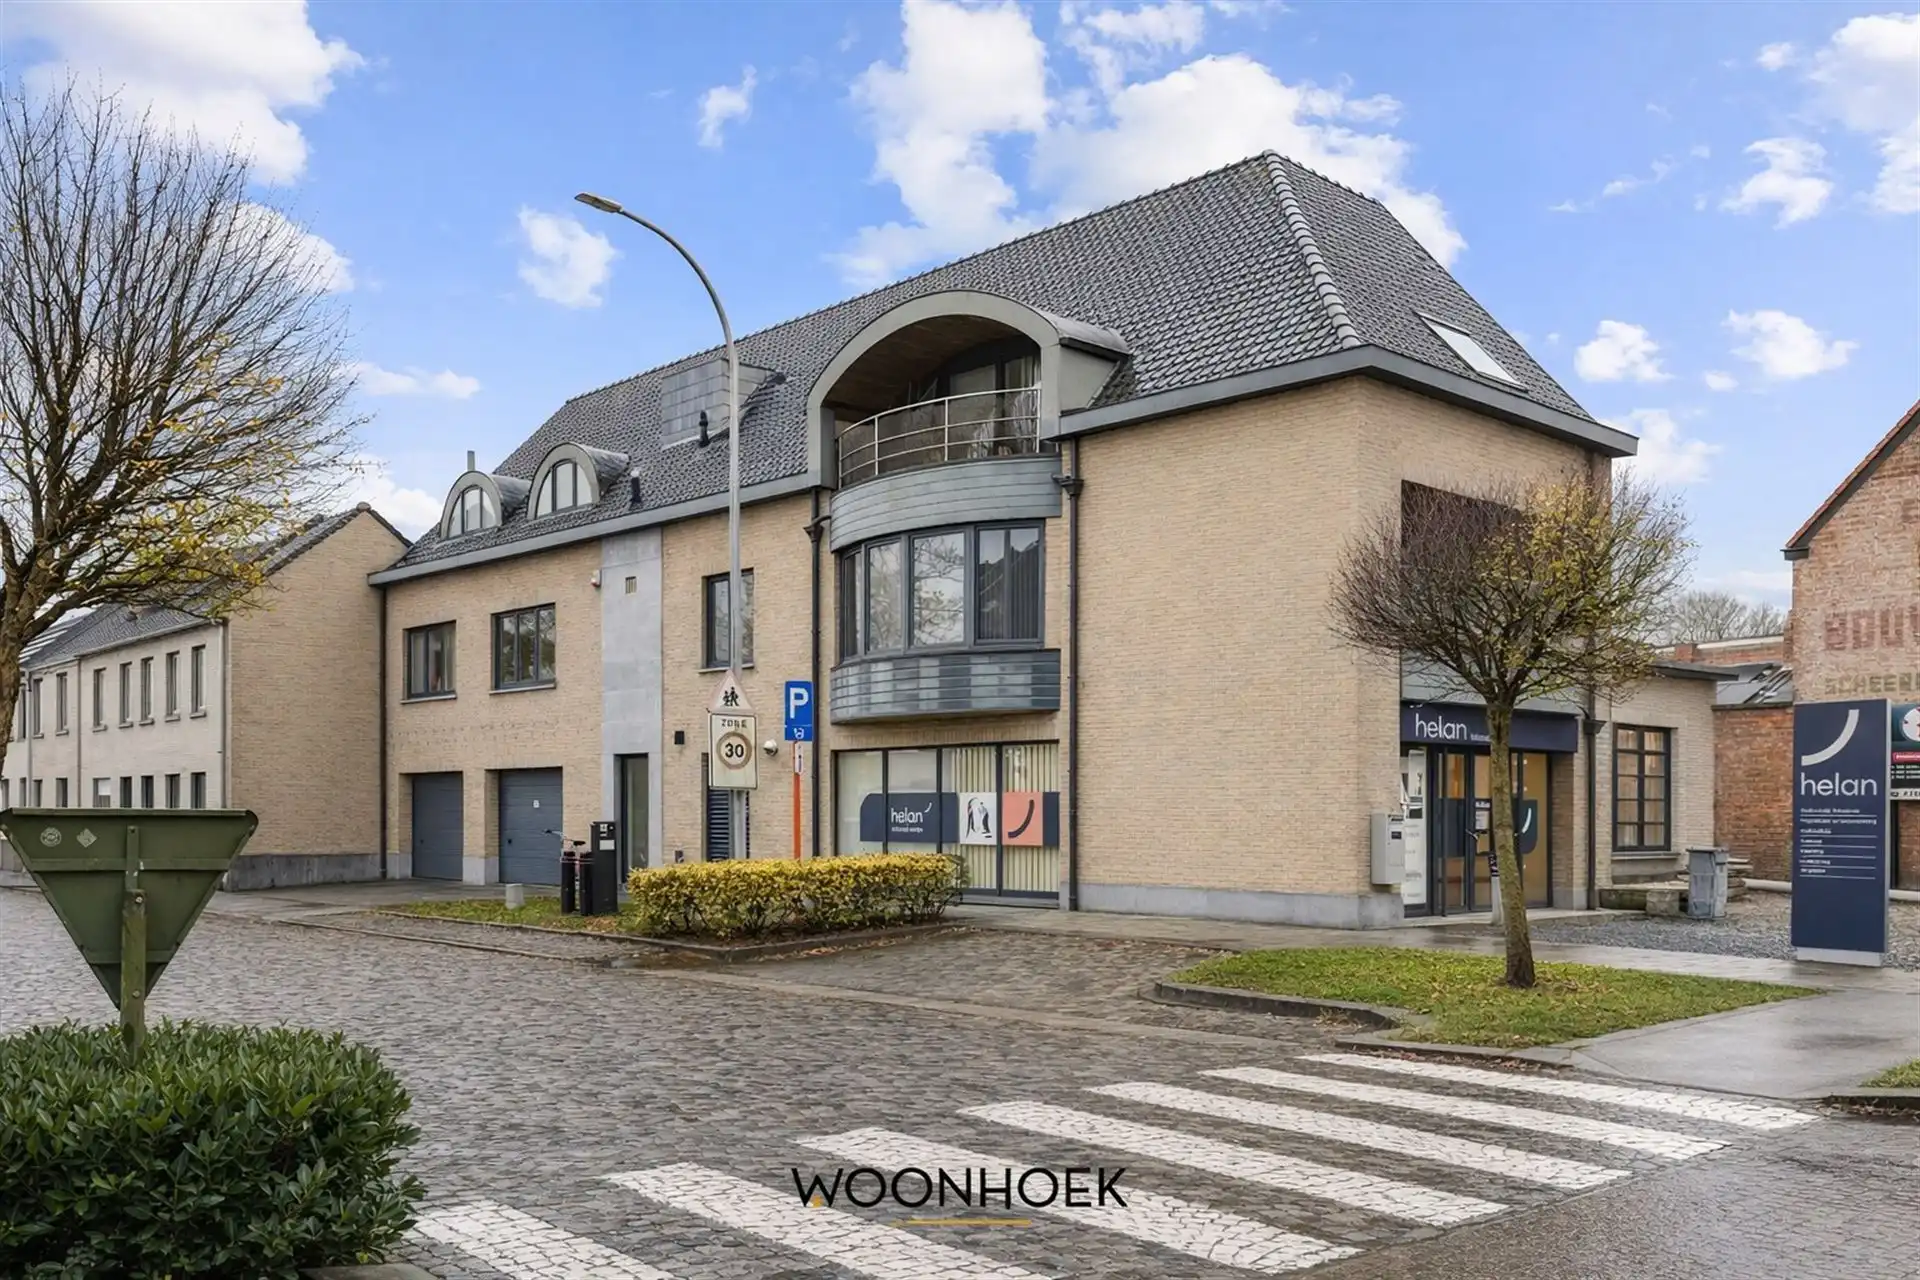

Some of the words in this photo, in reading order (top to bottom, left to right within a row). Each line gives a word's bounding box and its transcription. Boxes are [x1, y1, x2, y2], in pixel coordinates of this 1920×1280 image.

[789, 687, 809, 719] P
[720, 718, 747, 729] ZONE
[1415, 713, 1467, 740] helan
[724, 743, 745, 758] 30
[1800, 772, 1877, 796] helan
[891, 807, 923, 823] helan
